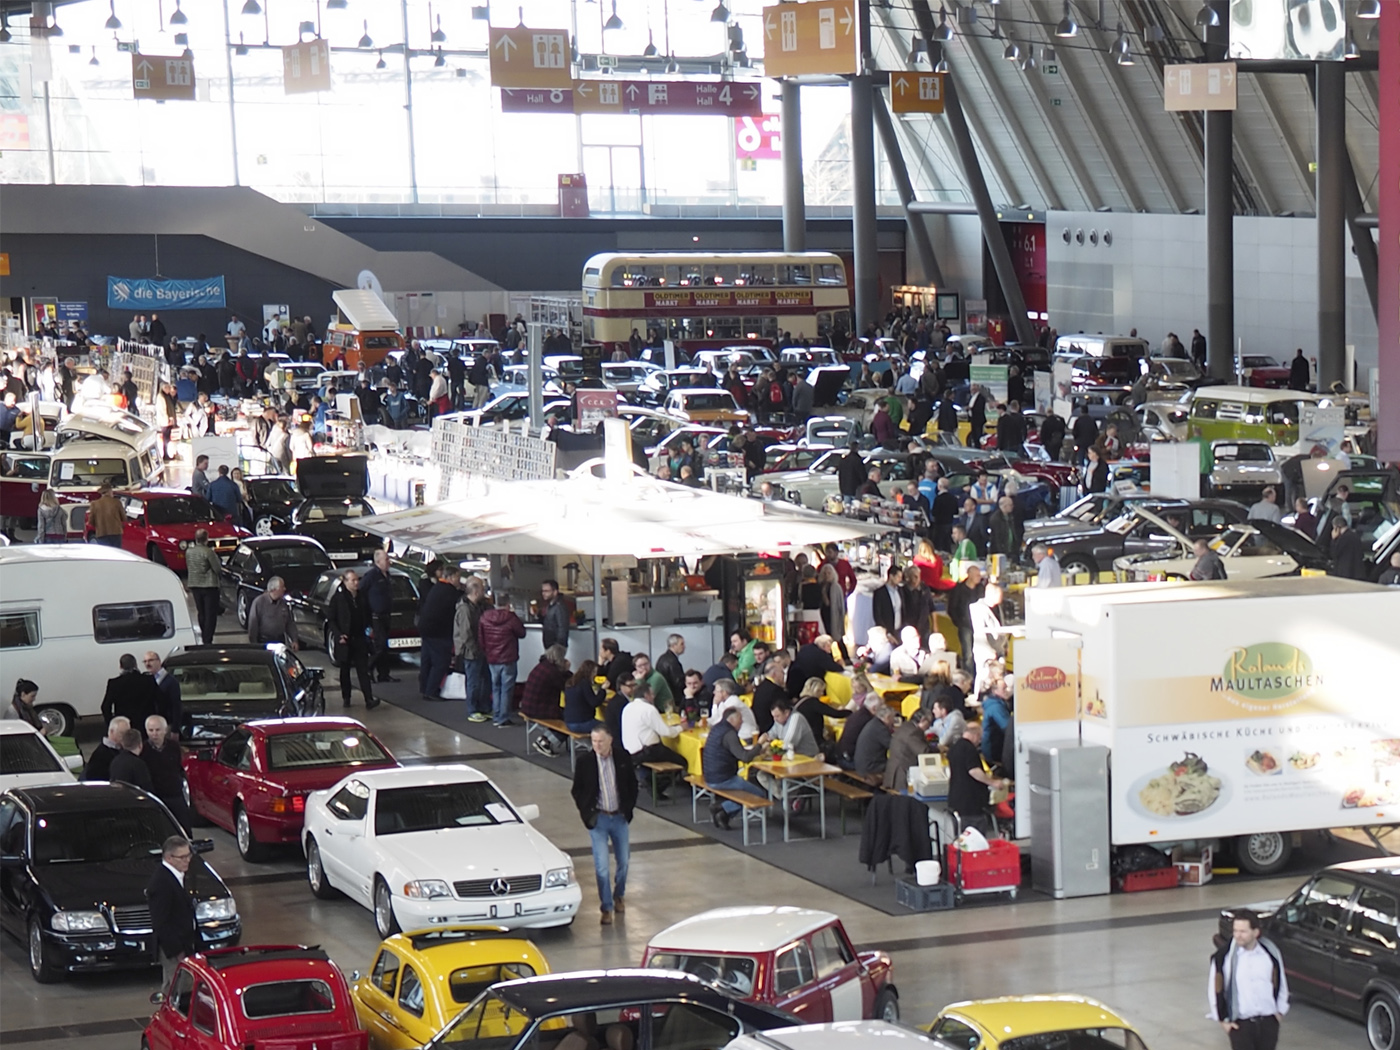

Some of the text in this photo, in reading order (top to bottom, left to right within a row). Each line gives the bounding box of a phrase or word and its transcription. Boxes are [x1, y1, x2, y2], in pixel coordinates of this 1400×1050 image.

[527, 94, 544, 103] Hall
[696, 85, 733, 106] Halle 4
[697, 97, 713, 106] Hall
[134, 288, 153, 299] die
[1147, 730, 1229, 743] SCHWÄBISCHE
[1236, 726, 1273, 737] KÜCHE
